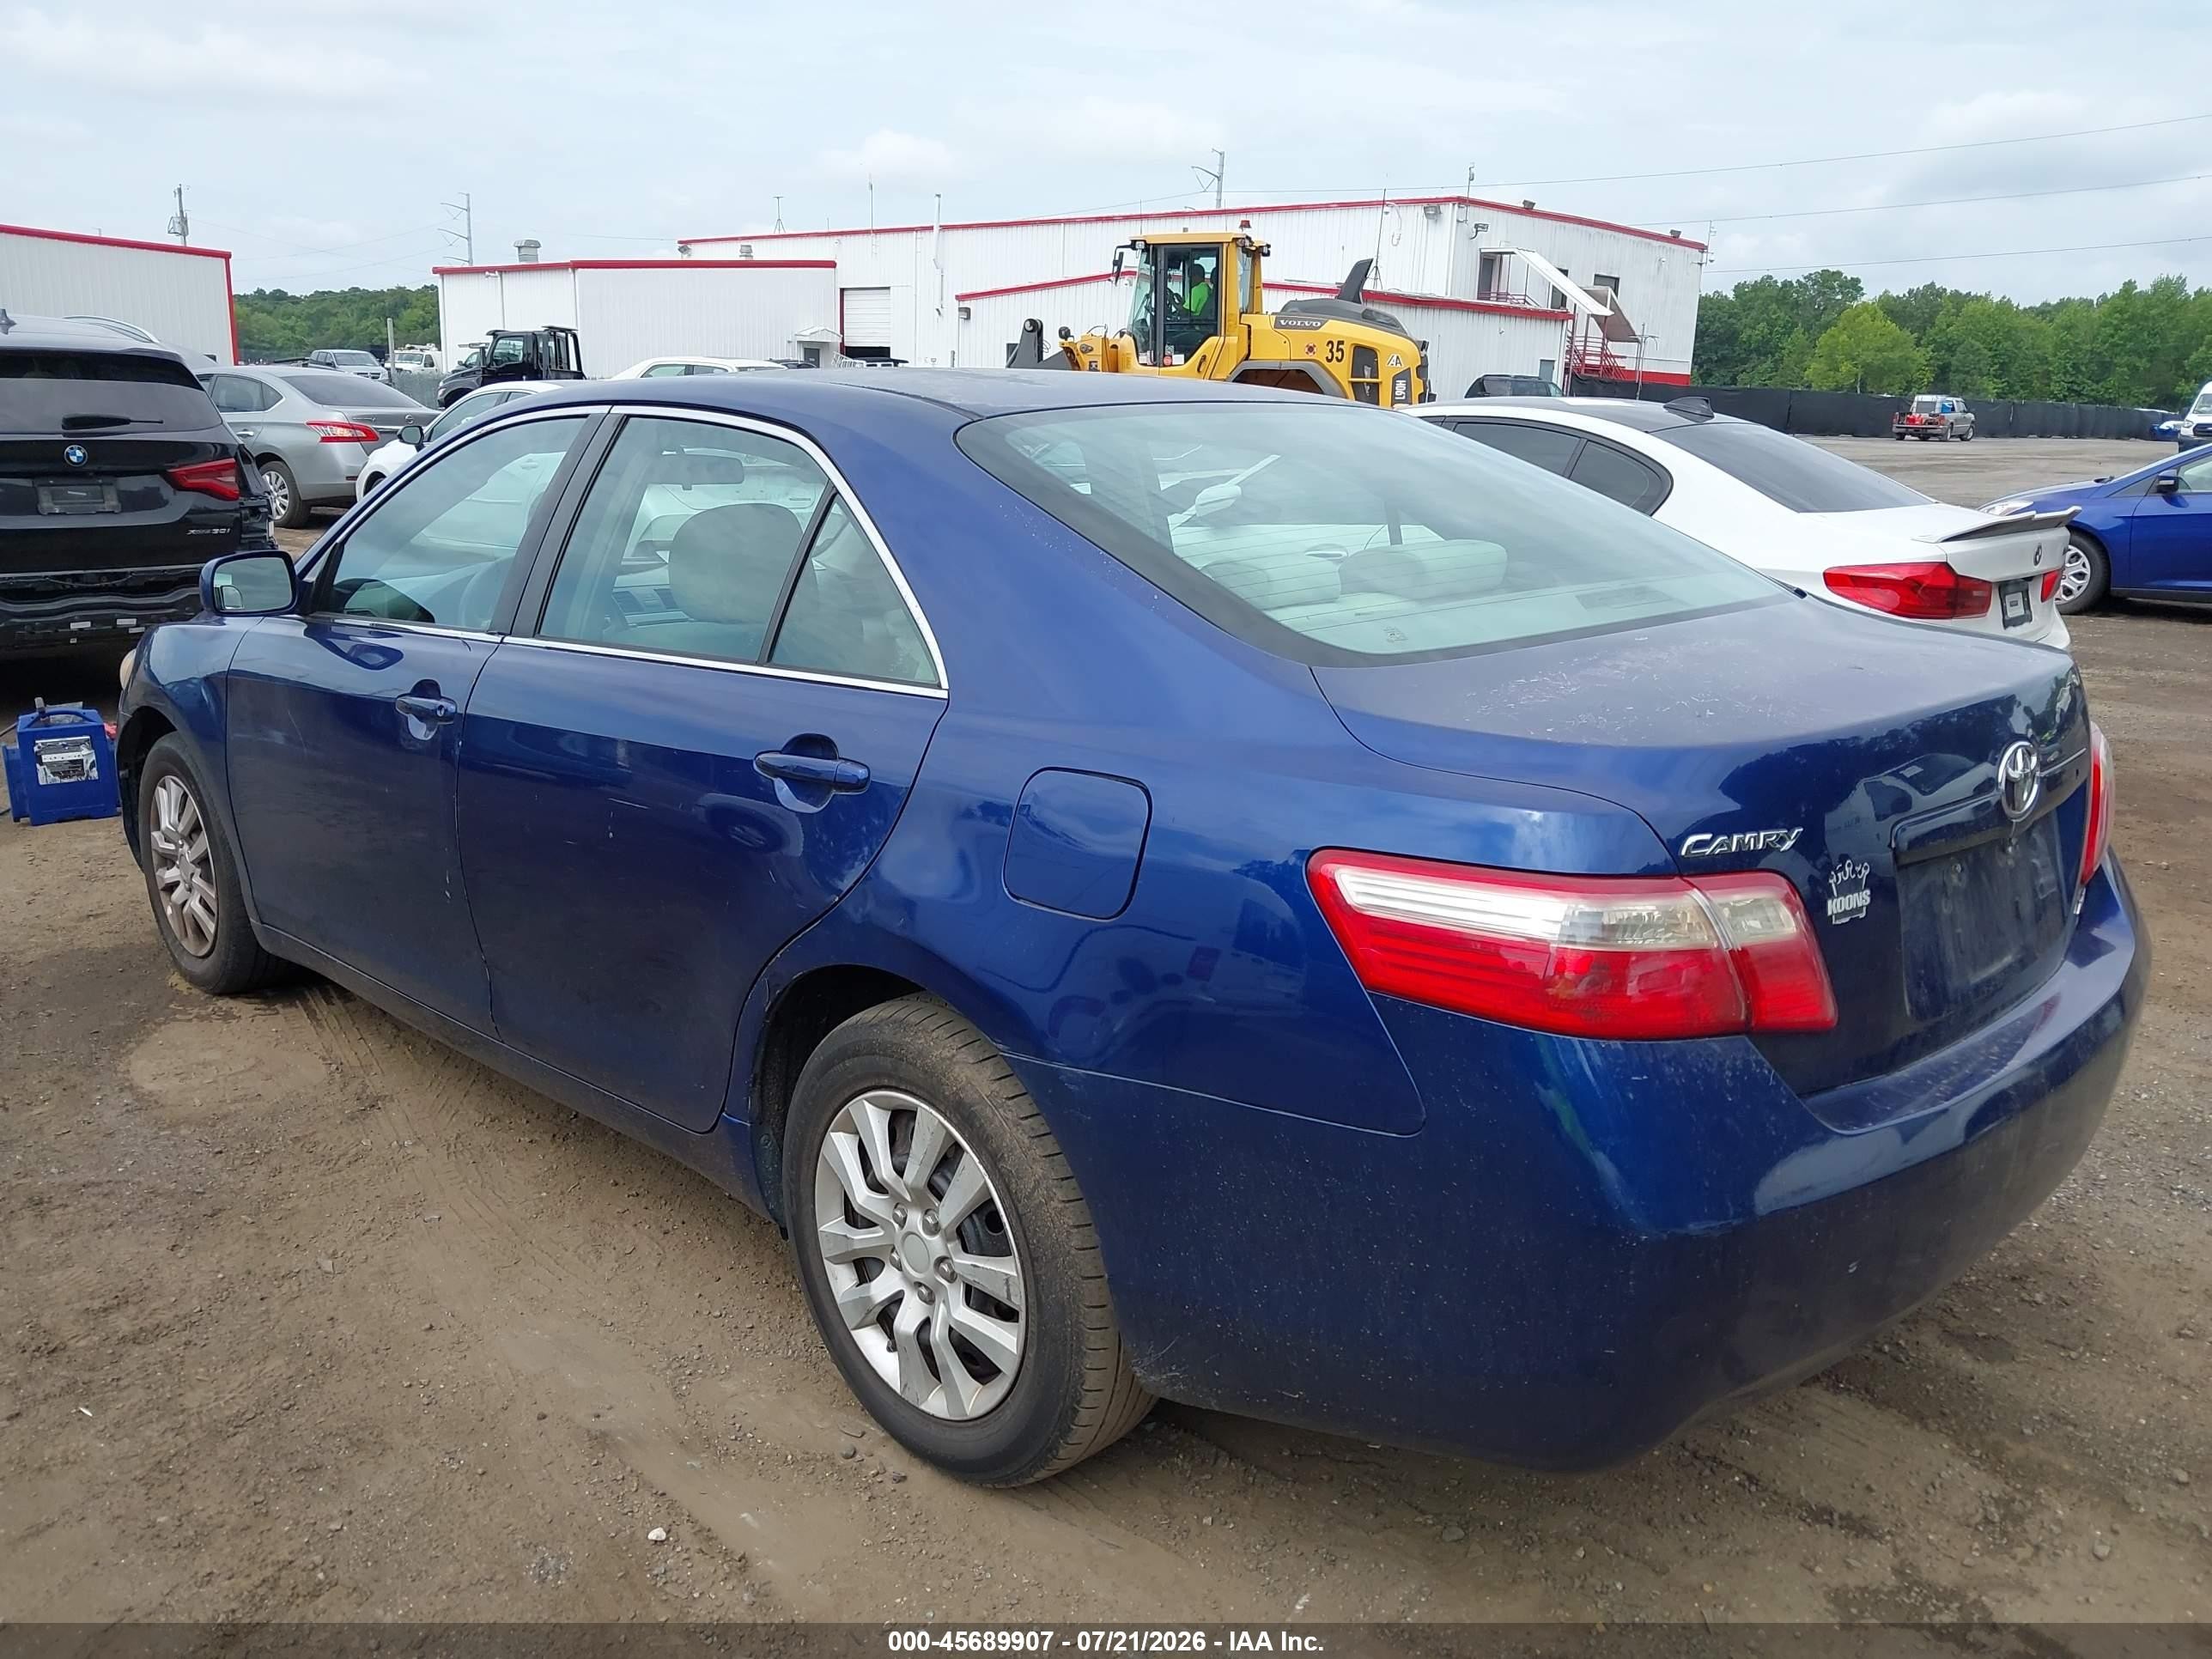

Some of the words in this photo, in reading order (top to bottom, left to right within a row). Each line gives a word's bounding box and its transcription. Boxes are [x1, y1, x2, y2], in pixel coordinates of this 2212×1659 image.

[1279, 319, 1322, 328] VOLVO
[1325, 340, 1345, 363] 35
[1395, 380, 1407, 400] L90H
[1680, 827, 1804, 858] CAMRY
[1827, 889, 1871, 916] KOONS
